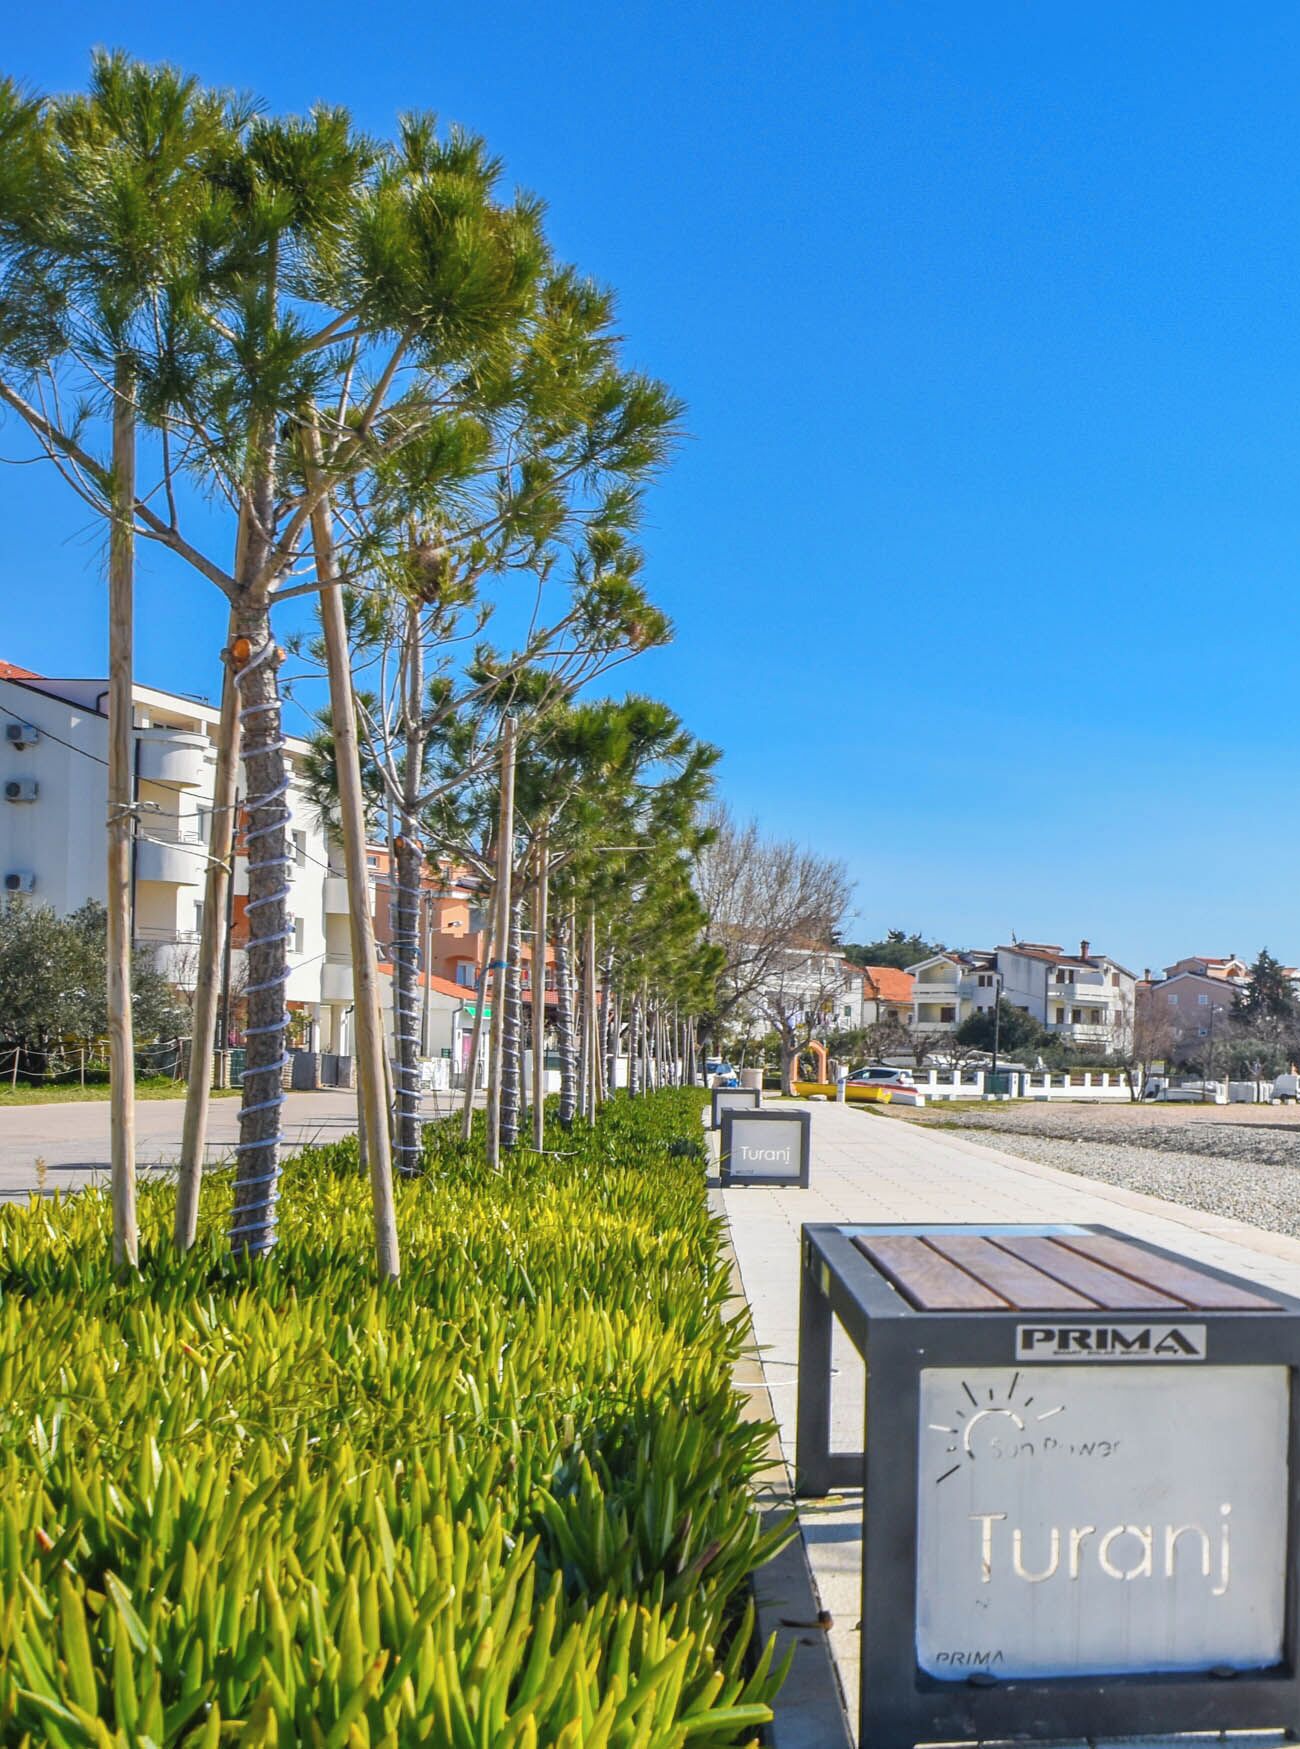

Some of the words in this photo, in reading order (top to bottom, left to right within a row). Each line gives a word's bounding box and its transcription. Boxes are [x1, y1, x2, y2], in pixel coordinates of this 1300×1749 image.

[740, 1145, 791, 1166] Turanj
[1021, 1328, 1200, 1355] PRIMA
[968, 1502, 1232, 1596] Turanj
[936, 1650, 1005, 1666] PRIMA
